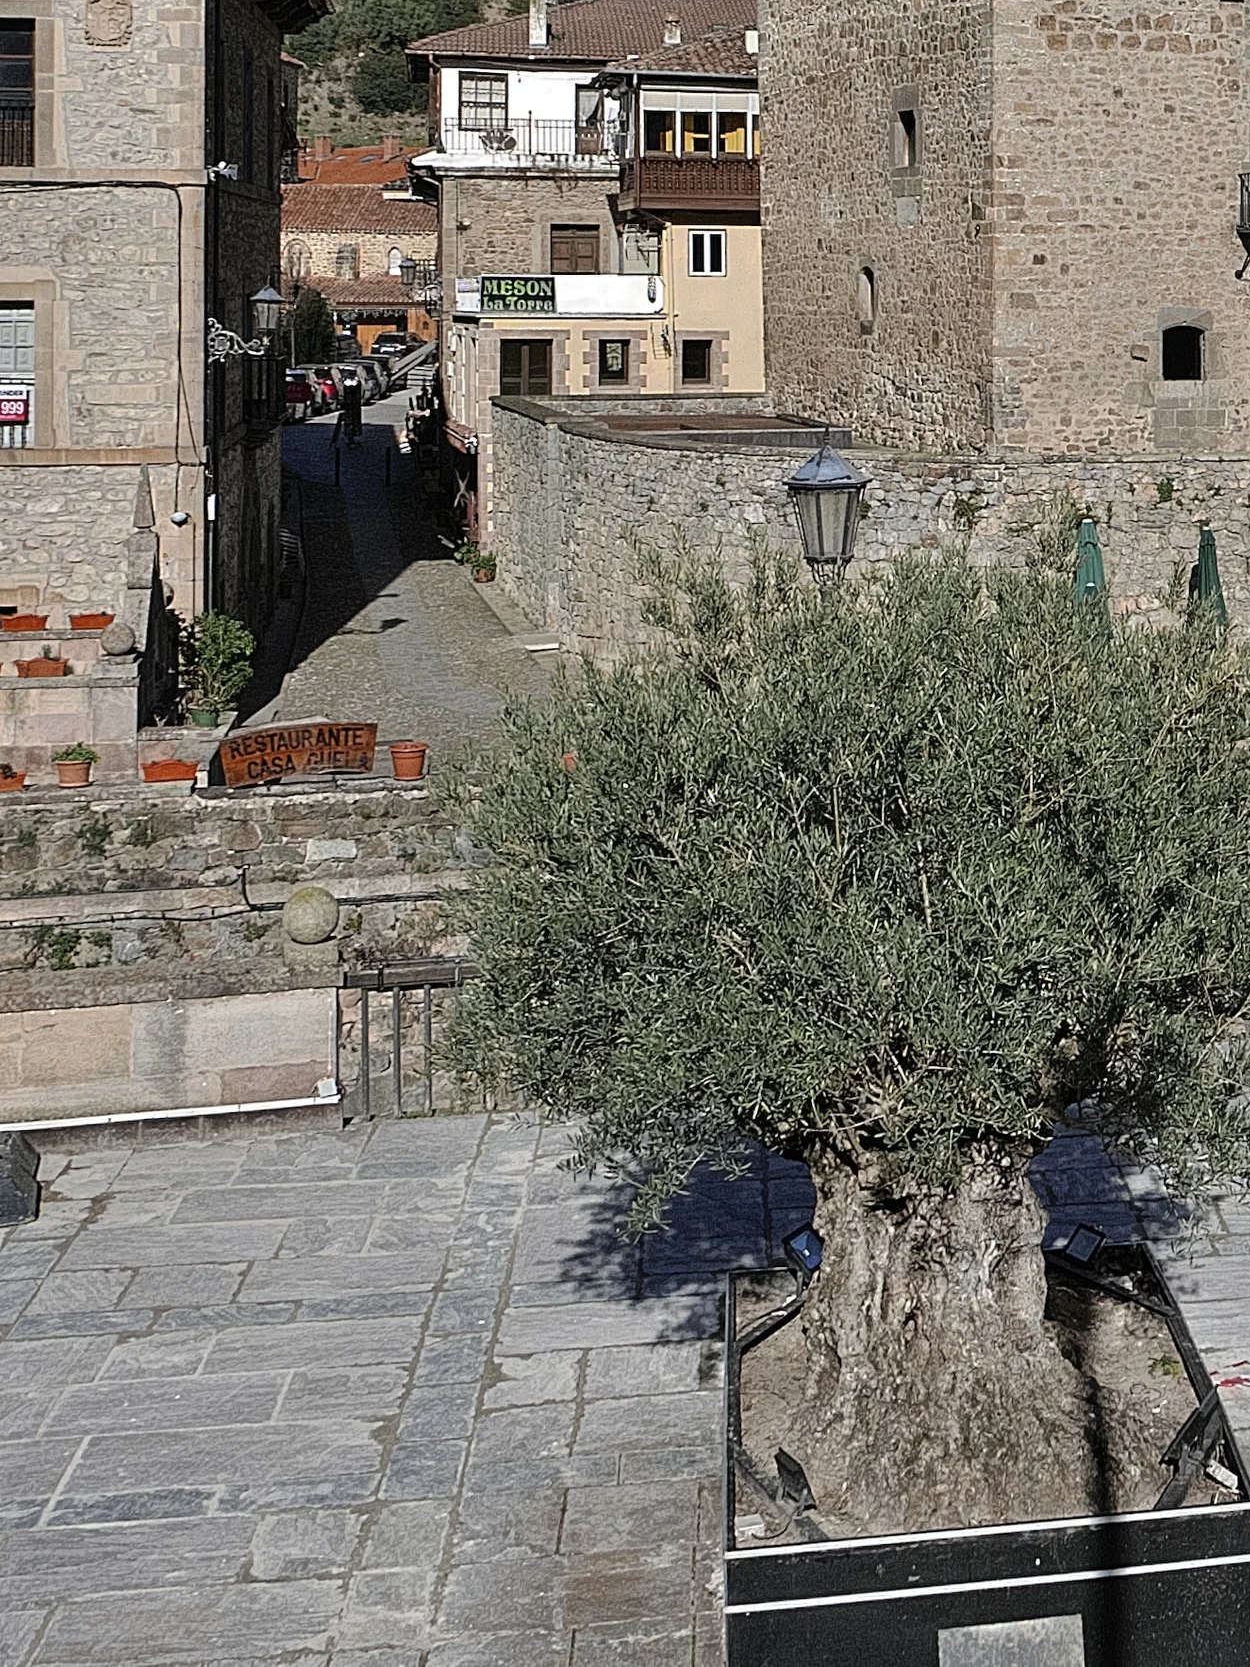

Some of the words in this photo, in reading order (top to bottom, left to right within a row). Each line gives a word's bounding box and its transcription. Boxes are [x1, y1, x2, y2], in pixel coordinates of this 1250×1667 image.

[483, 279, 553, 296] MESON
[483, 296, 506, 311] La
[506, 296, 554, 311] Torre
[228, 727, 364, 760] RESTAURANTE
[247, 754, 297, 780] CASA
